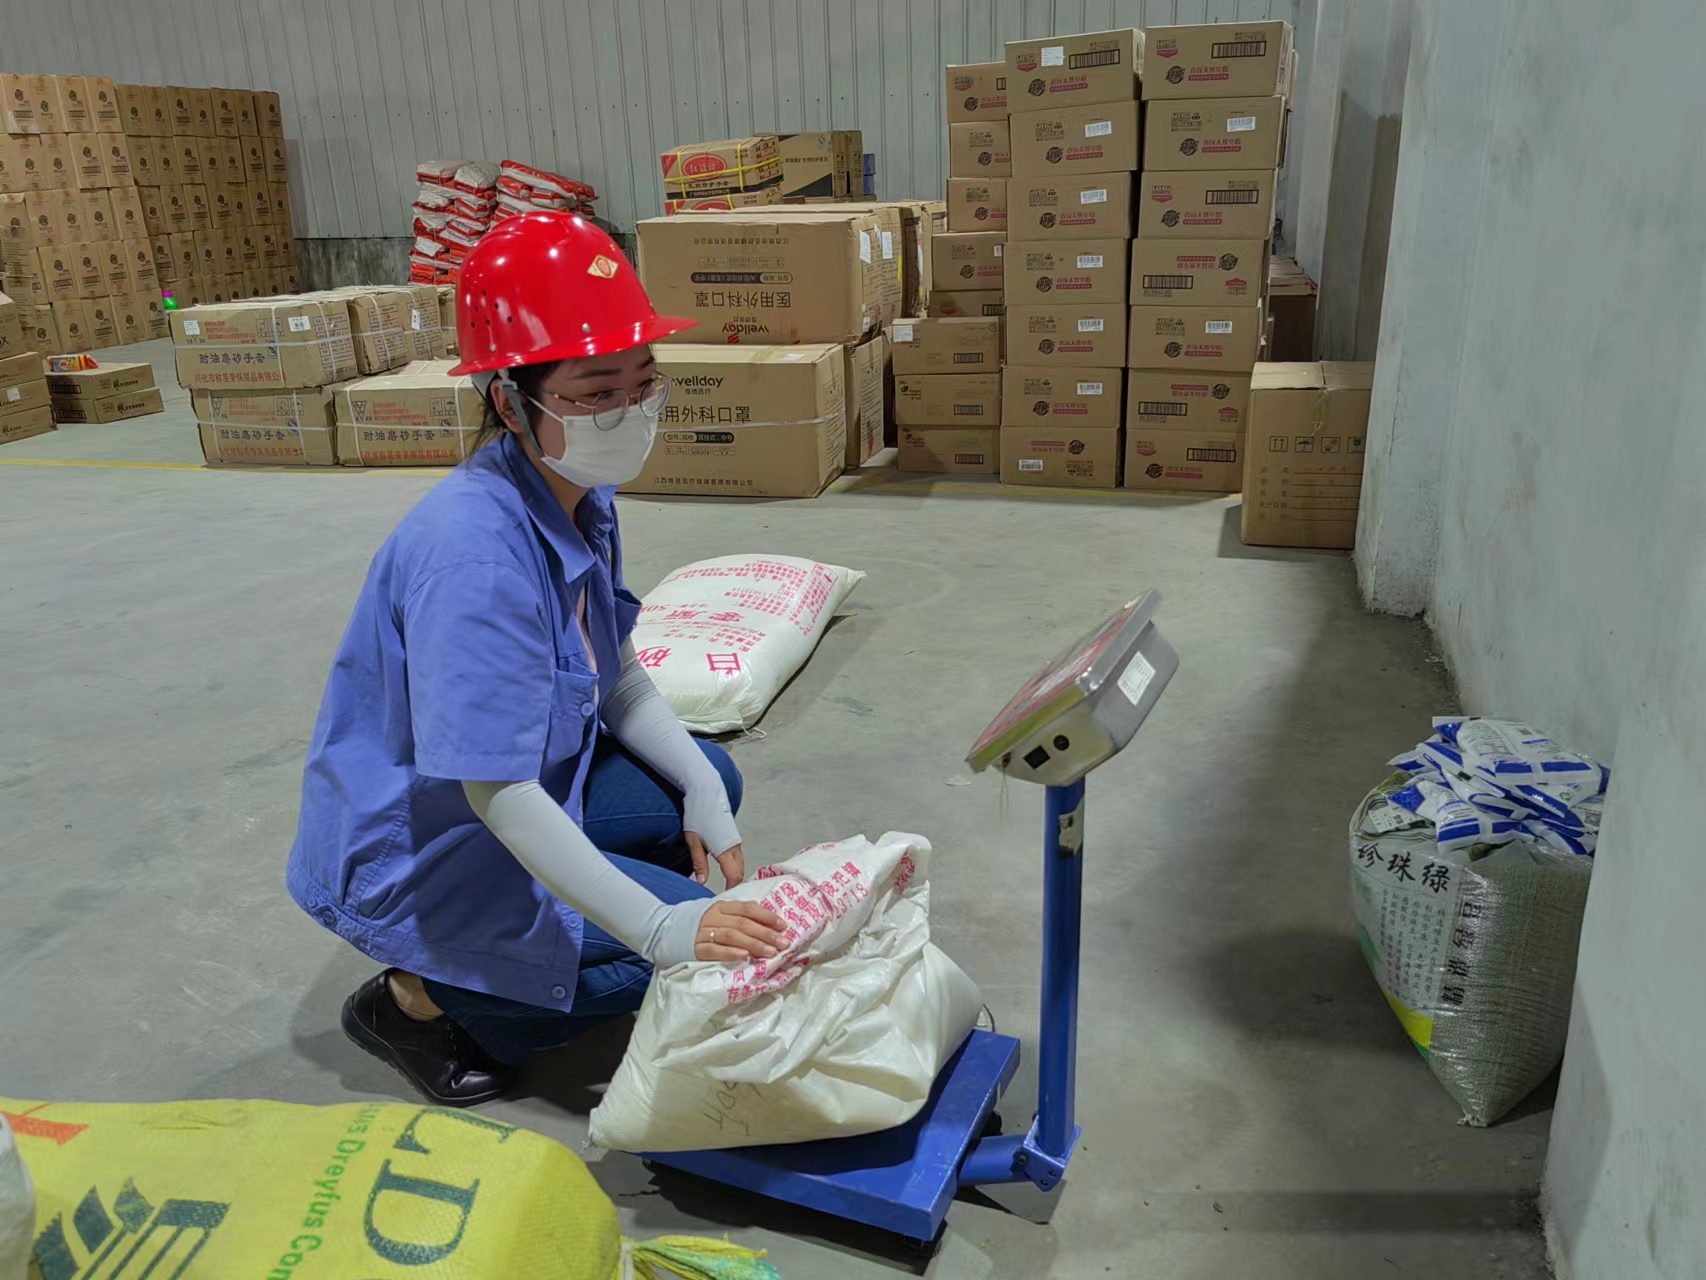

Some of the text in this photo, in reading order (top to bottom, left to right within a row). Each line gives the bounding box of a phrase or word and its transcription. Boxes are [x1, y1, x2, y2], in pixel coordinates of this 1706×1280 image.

[694, 291, 791, 308] 医用外科口罩
[1356, 842, 1451, 894] 珍珠绿
[304, 1139, 366, 1228] Dreyfus
